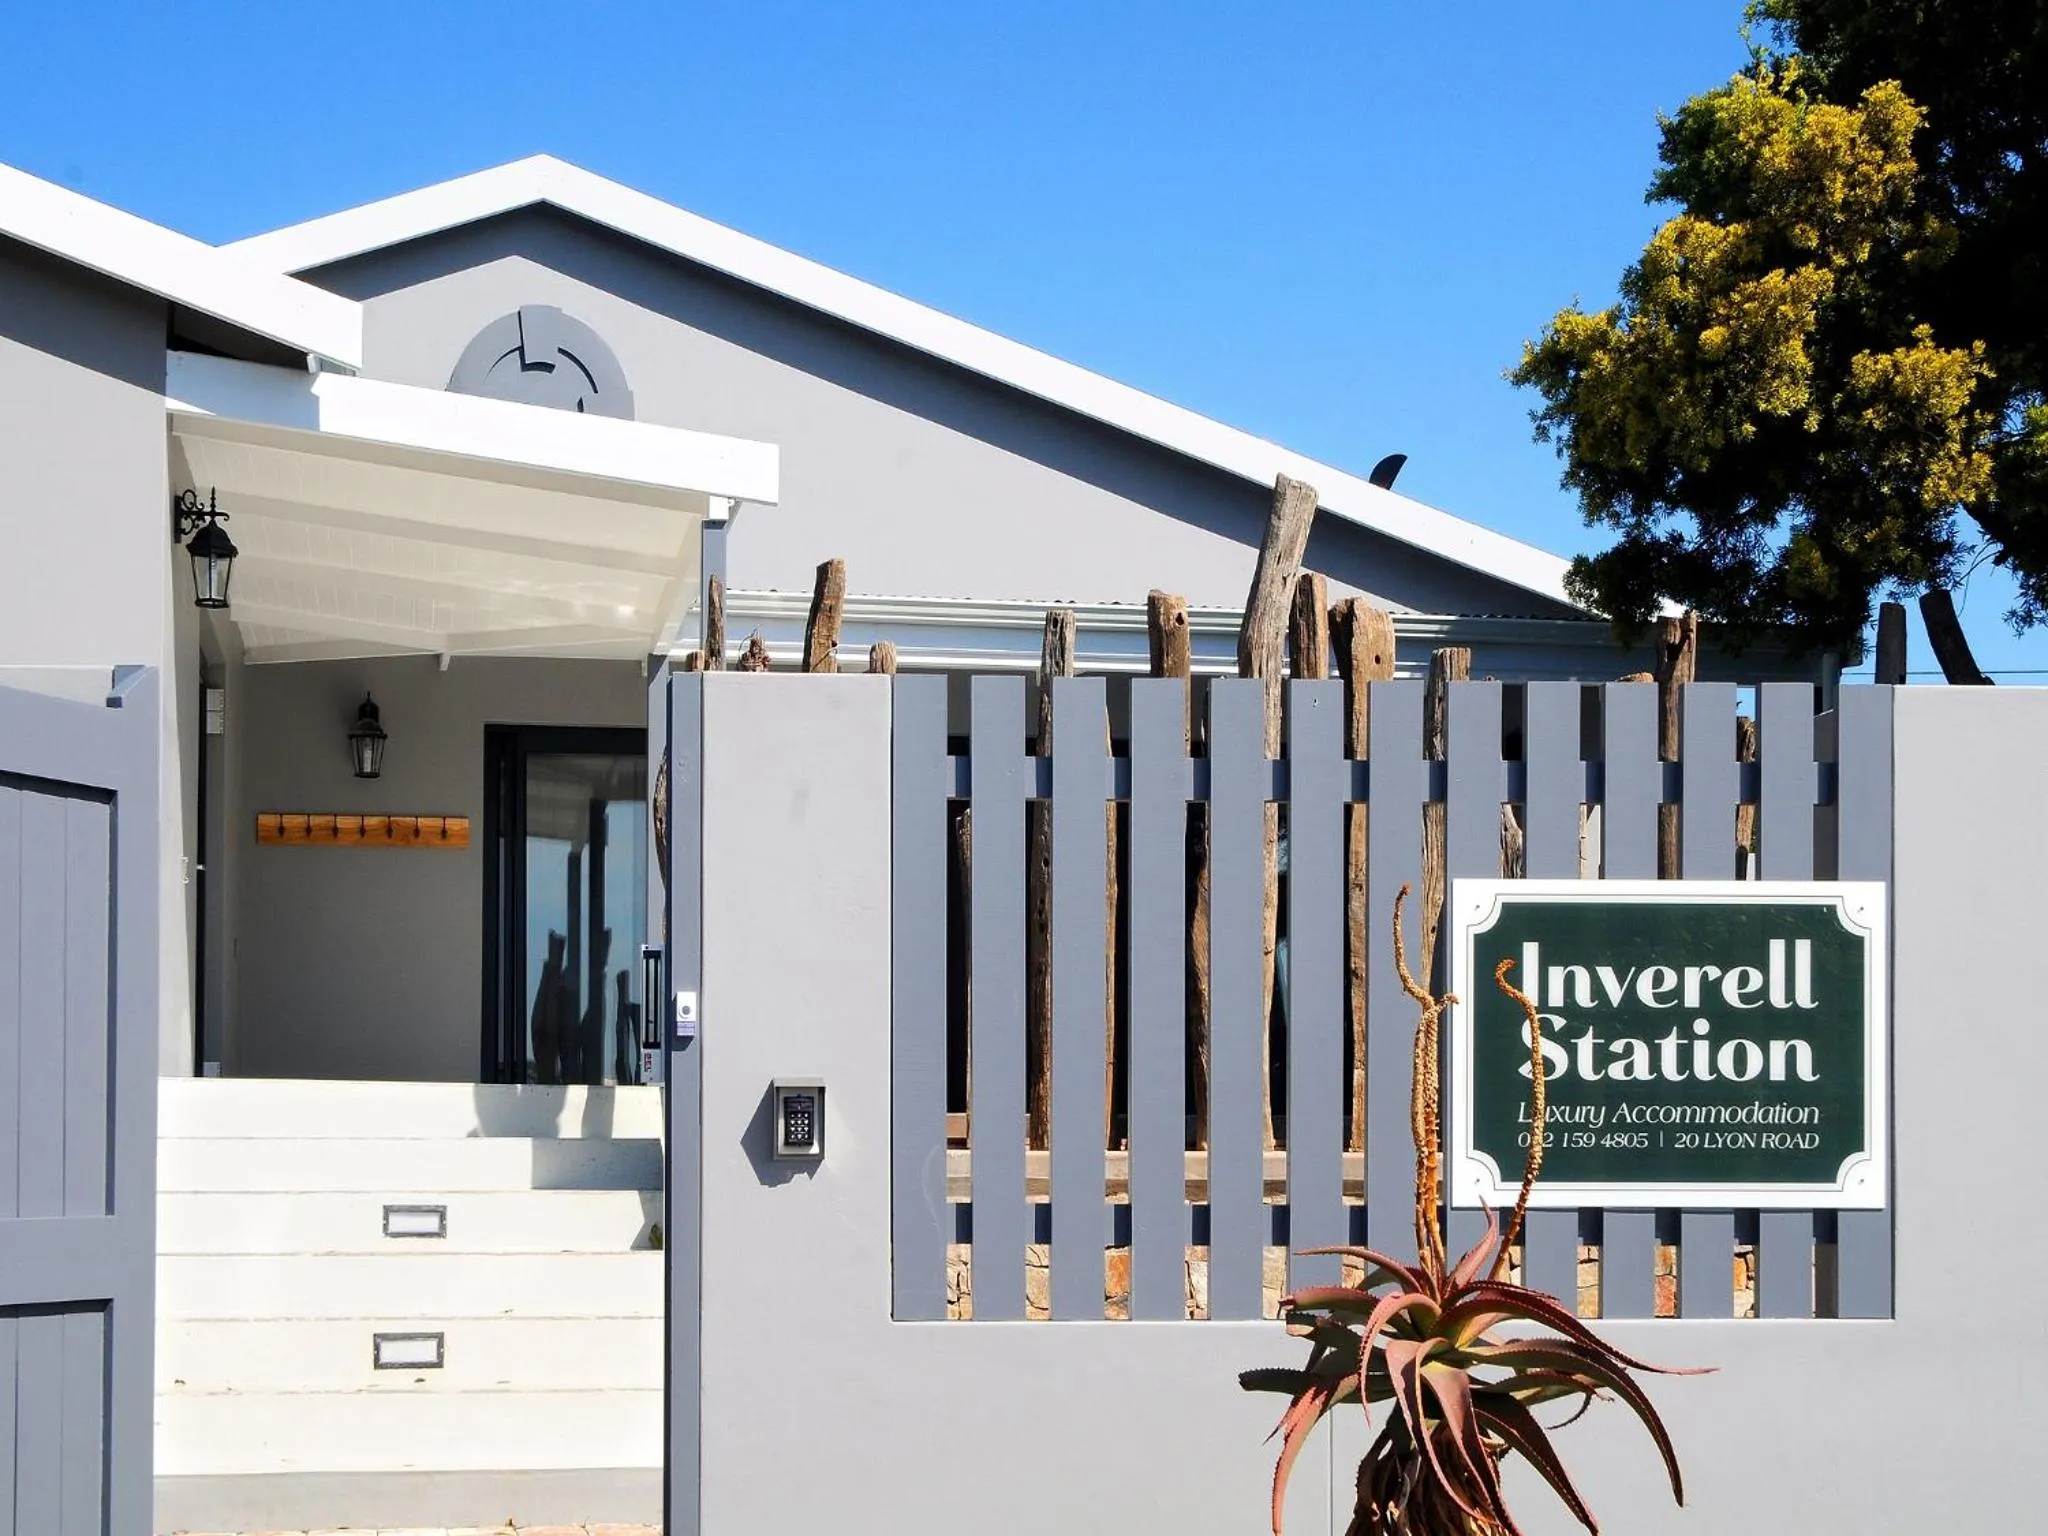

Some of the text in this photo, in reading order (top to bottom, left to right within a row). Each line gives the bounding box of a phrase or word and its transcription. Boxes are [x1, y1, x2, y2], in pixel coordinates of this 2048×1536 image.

[1522, 938, 1819, 1009] Inverell
[1518, 1013, 1820, 1081] Station
[1612, 1100, 1819, 1124] Accommodation
[1518, 1131, 1820, 1149] 02 159 4805 20 LYON ROAD
